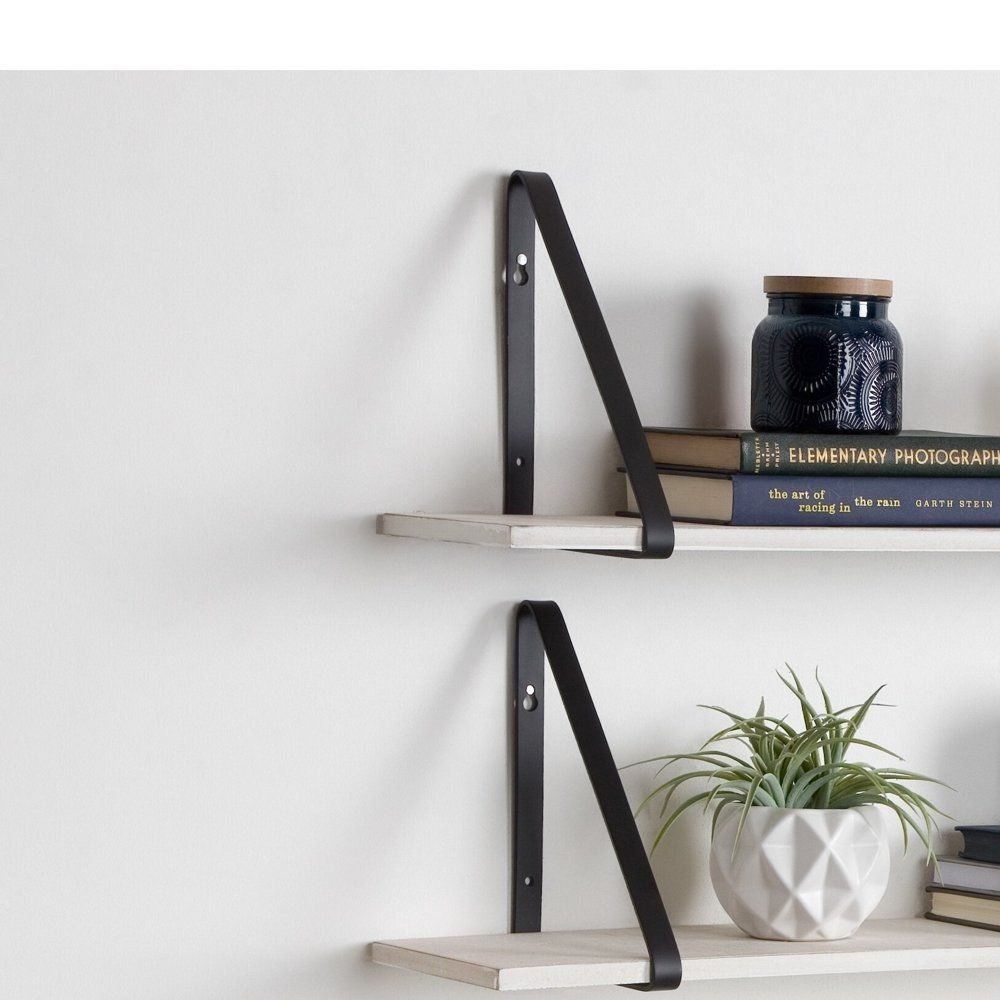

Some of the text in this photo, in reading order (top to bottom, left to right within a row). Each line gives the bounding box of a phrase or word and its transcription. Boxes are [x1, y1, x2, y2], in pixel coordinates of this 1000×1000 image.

[789, 447, 887, 464] ELEMENTARY
[769, 488, 826, 500] the art of
[854, 496, 873, 507] the
[915, 499, 993, 508] GARTH STEIN
[798, 502, 851, 514] racing in
